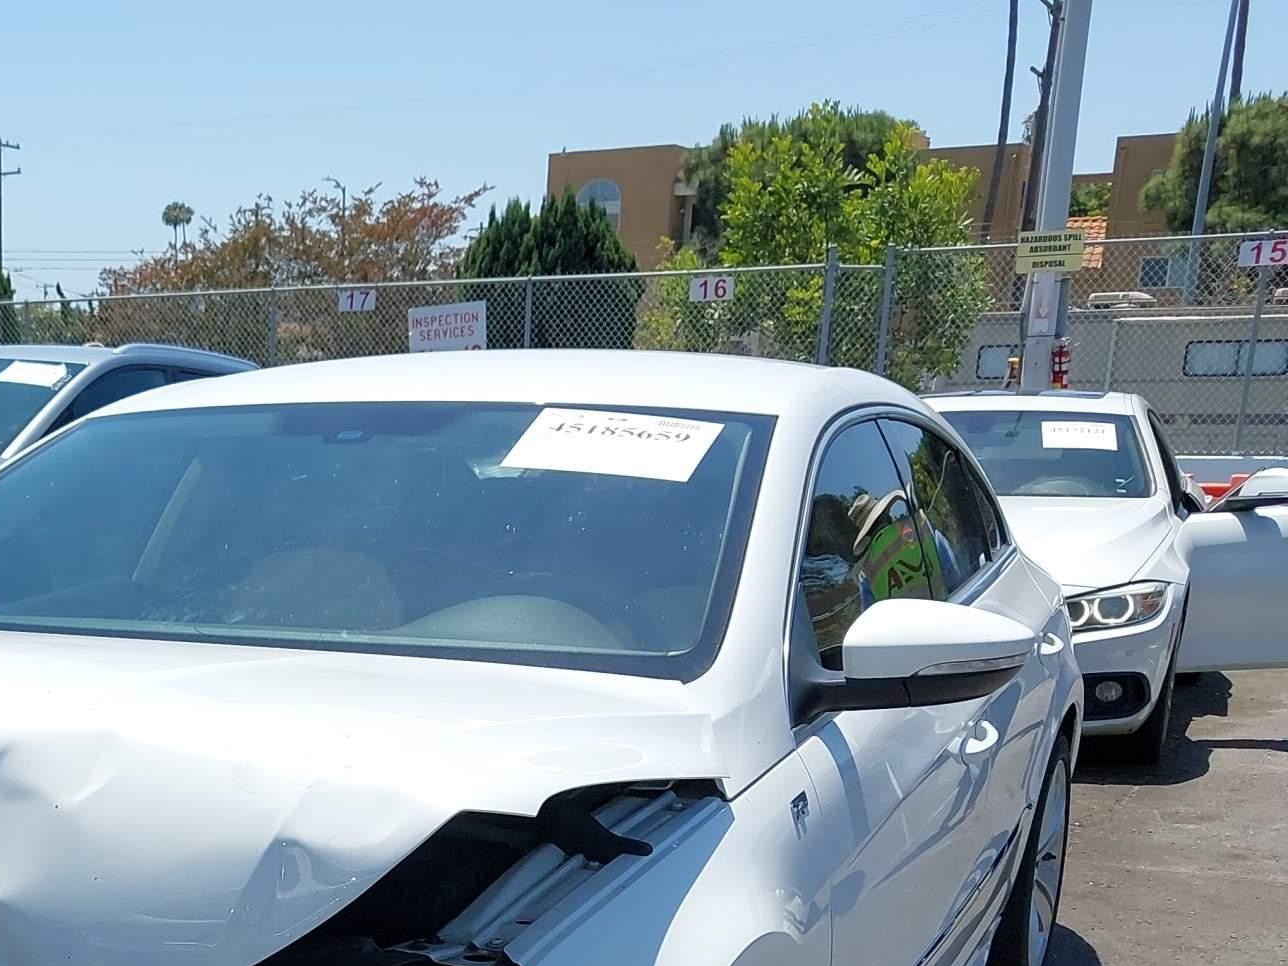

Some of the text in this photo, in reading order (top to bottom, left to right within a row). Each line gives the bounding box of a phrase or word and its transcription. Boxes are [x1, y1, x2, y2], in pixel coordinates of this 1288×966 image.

[1020, 233, 1082, 243] HAZARDOUS SPILL
[1250, 240, 1287, 264] 15
[1032, 260, 1065, 268] DISPOSAL
[699, 279, 727, 299] 16
[346, 291, 370, 310] 17
[412, 312, 479, 329] INSPECTION
[419, 325, 475, 342] SERVICES
[548, 422, 692, 443] 45185659
